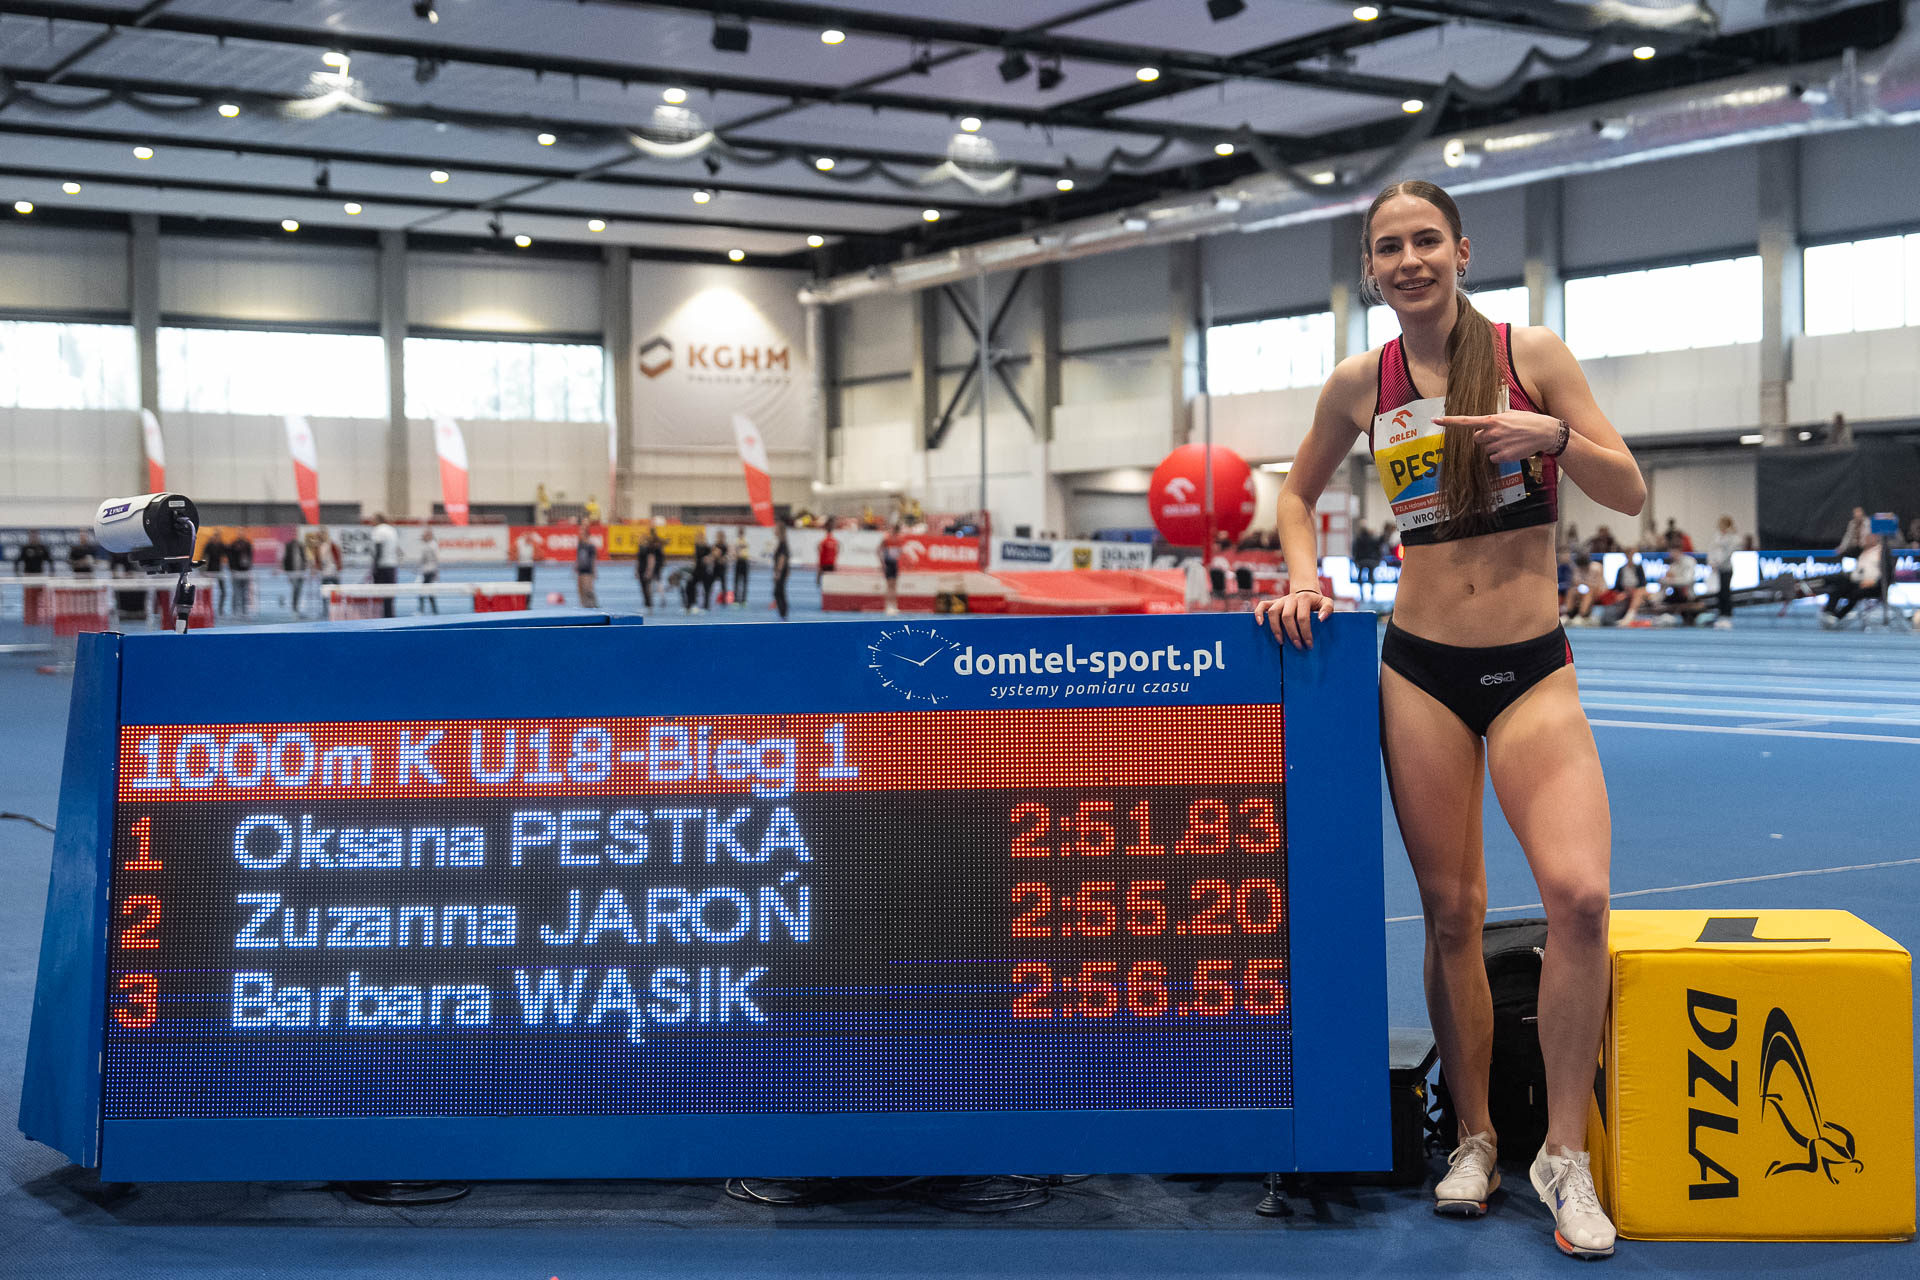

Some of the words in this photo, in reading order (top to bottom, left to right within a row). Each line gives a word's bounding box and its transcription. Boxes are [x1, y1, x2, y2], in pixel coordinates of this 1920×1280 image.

[687, 345, 790, 371] KGHM
[1389, 429, 1417, 444] ORLEN
[953, 640, 1225, 678] domtel-sport.pl
[1480, 671, 1515, 686] esa
[990, 682, 1059, 698] systemy
[1065, 680, 1135, 697] pomiaru
[1142, 680, 1191, 694] czasu
[131, 732, 373, 790] 1000m
[398, 728, 447, 786] K
[470, 724, 797, 799] U18-Bieg
[817, 722, 860, 780] 1
[123, 816, 163, 871] 1
[232, 813, 486, 870] Oksana
[510, 807, 814, 867] PESTKA
[1010, 798, 1281, 857] 2:51.83
[120, 893, 162, 950] 2
[233, 890, 517, 949] Zuzanna
[539, 870, 812, 945] JAROŃ
[1011, 878, 1282, 938] 2:55.20
[114, 971, 159, 1029] 3
[231, 970, 492, 1028] Barbara
[514, 966, 769, 1043] WĄSIK
[1012, 959, 1284, 1018] 2:56.55
[1686, 987, 1739, 1201] DZLA
